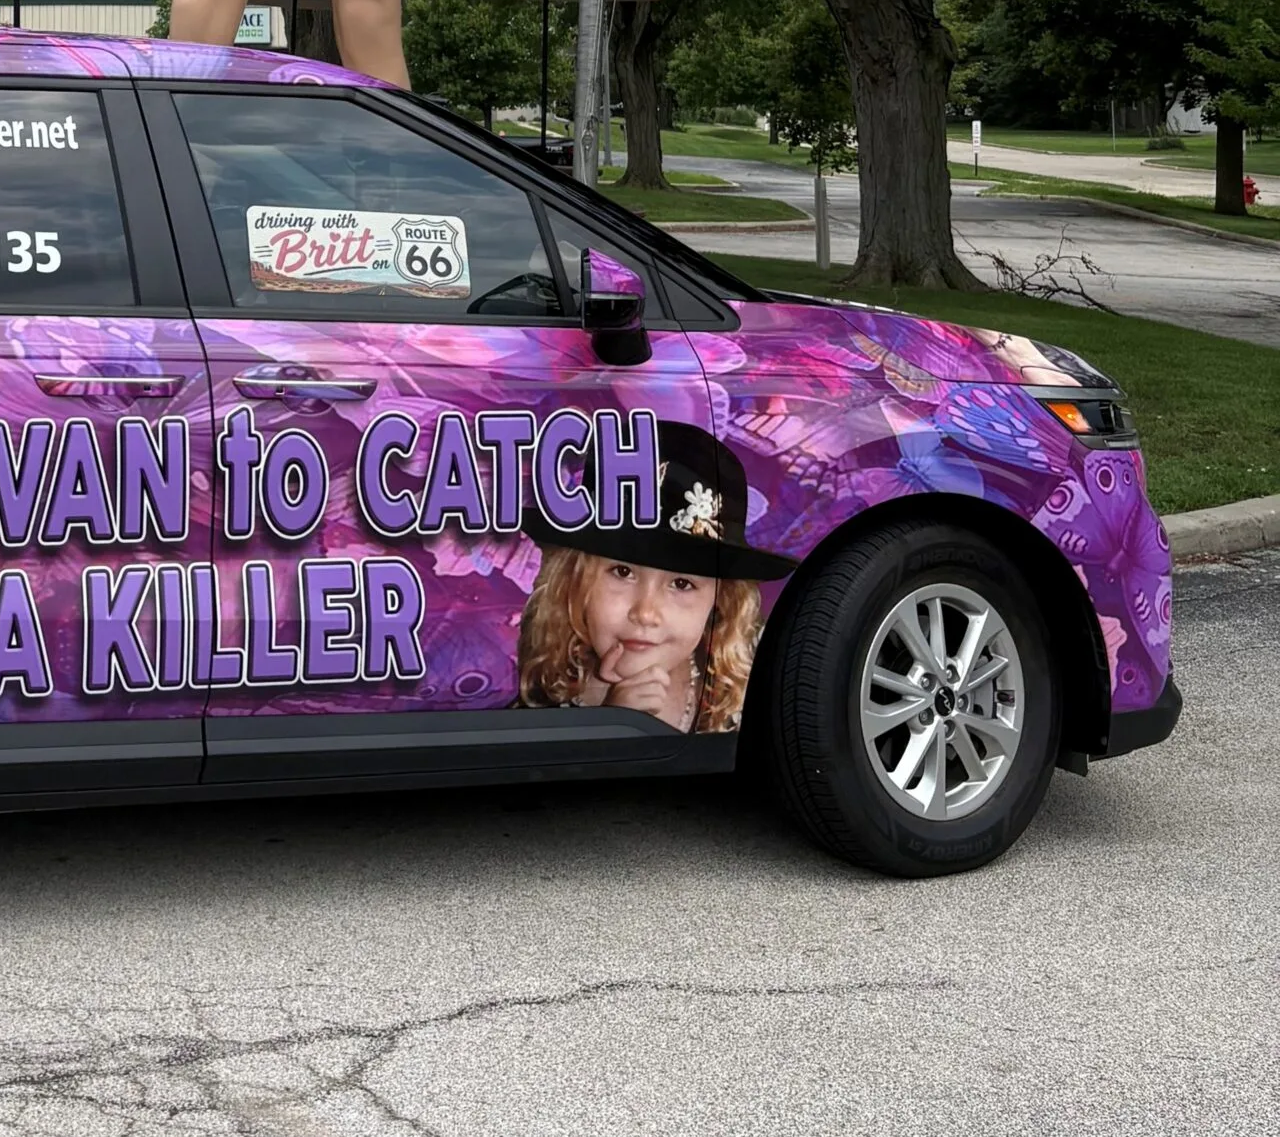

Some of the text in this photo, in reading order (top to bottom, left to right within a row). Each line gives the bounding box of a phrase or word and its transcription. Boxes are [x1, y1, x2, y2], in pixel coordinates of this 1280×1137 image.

[254, 212, 359, 233] driving with
[405, 228, 447, 241] ROUTE
[269, 228, 375, 273] Britt
[372, 259, 391, 270] on
[406, 245, 452, 278] 66
[218, 403, 329, 540] to
[356, 408, 661, 537] CATCH
[81, 556, 425, 694] KILLER
